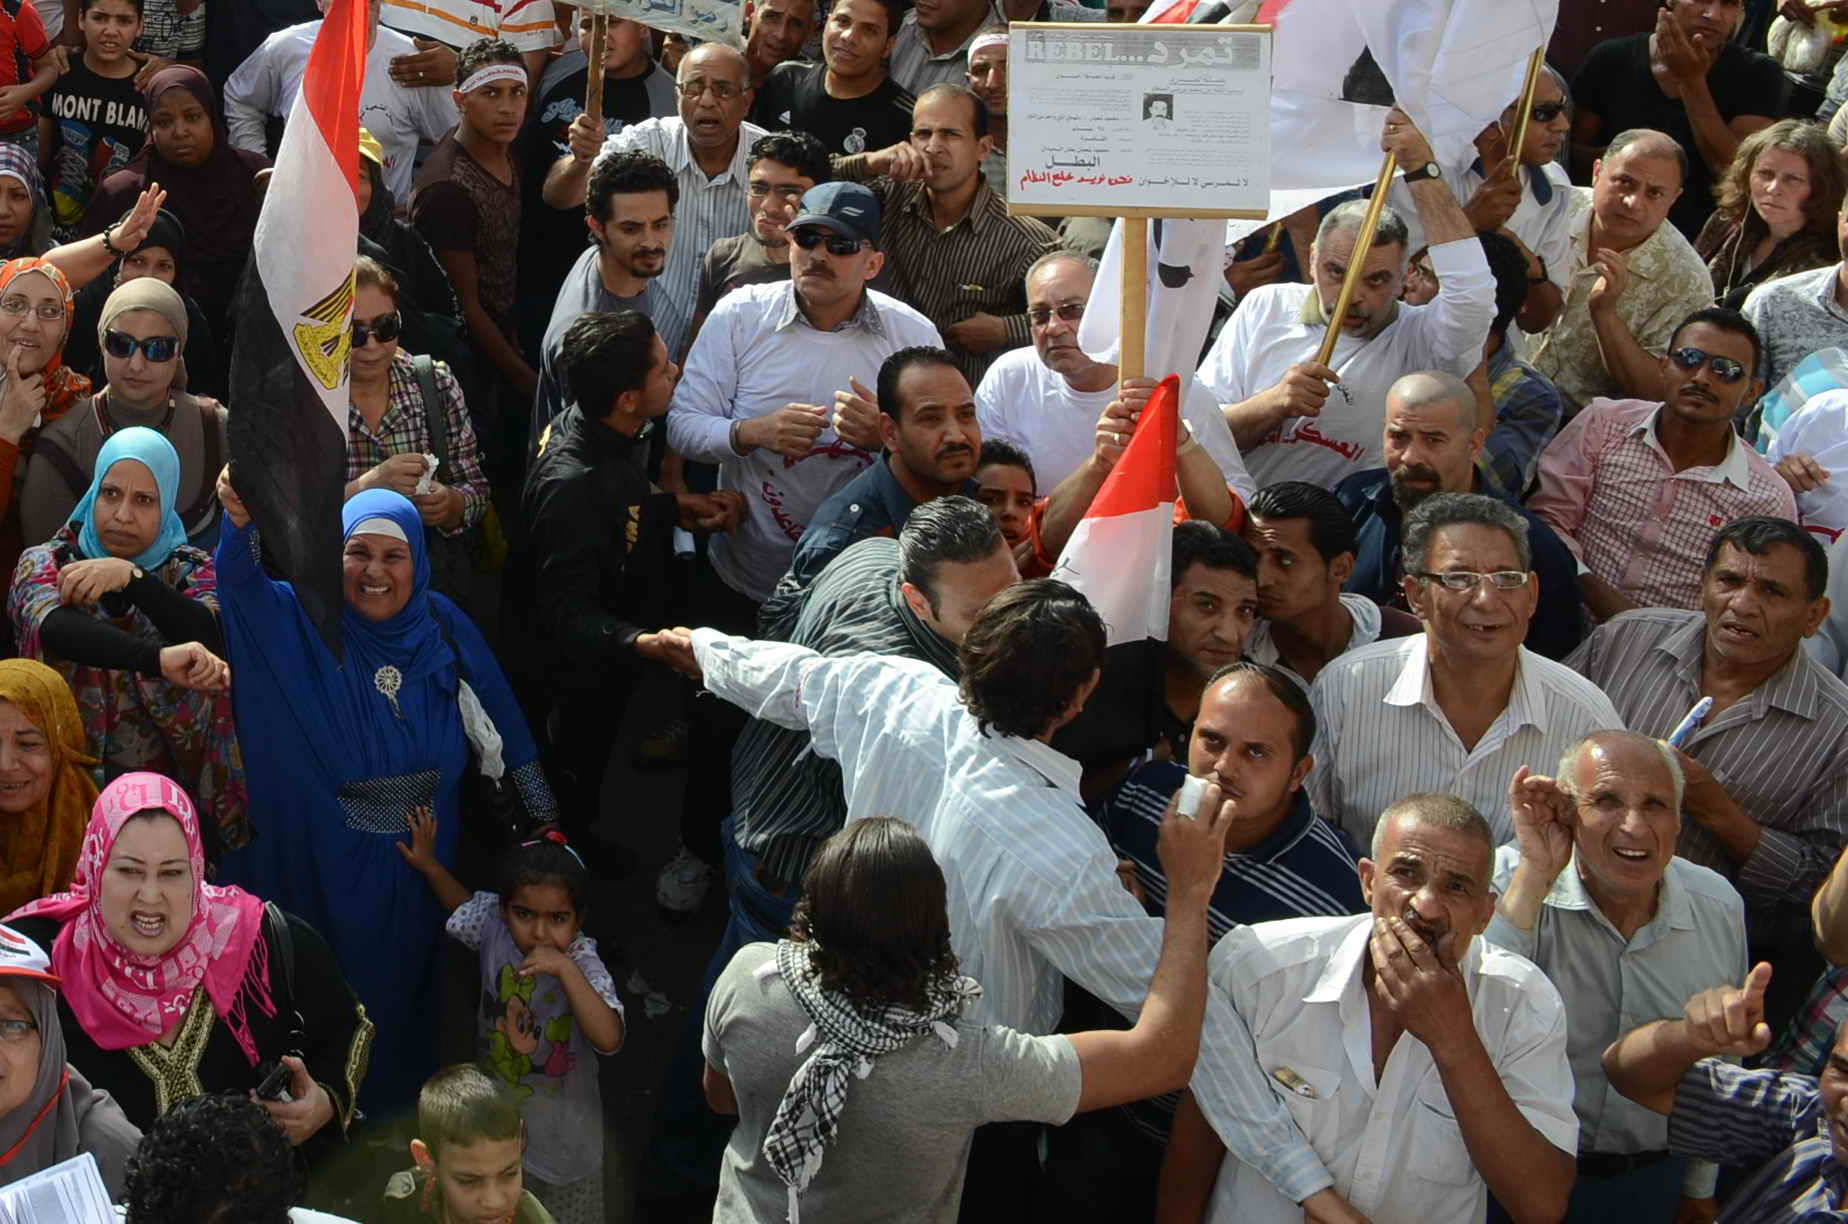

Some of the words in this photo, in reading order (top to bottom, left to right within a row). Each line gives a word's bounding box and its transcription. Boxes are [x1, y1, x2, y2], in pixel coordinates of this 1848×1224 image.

[689, 5, 729, 32] رمز
[1146, 36, 1233, 70] تمرد
[51, 92, 103, 123] MONT
[105, 101, 151, 133] BLAN
